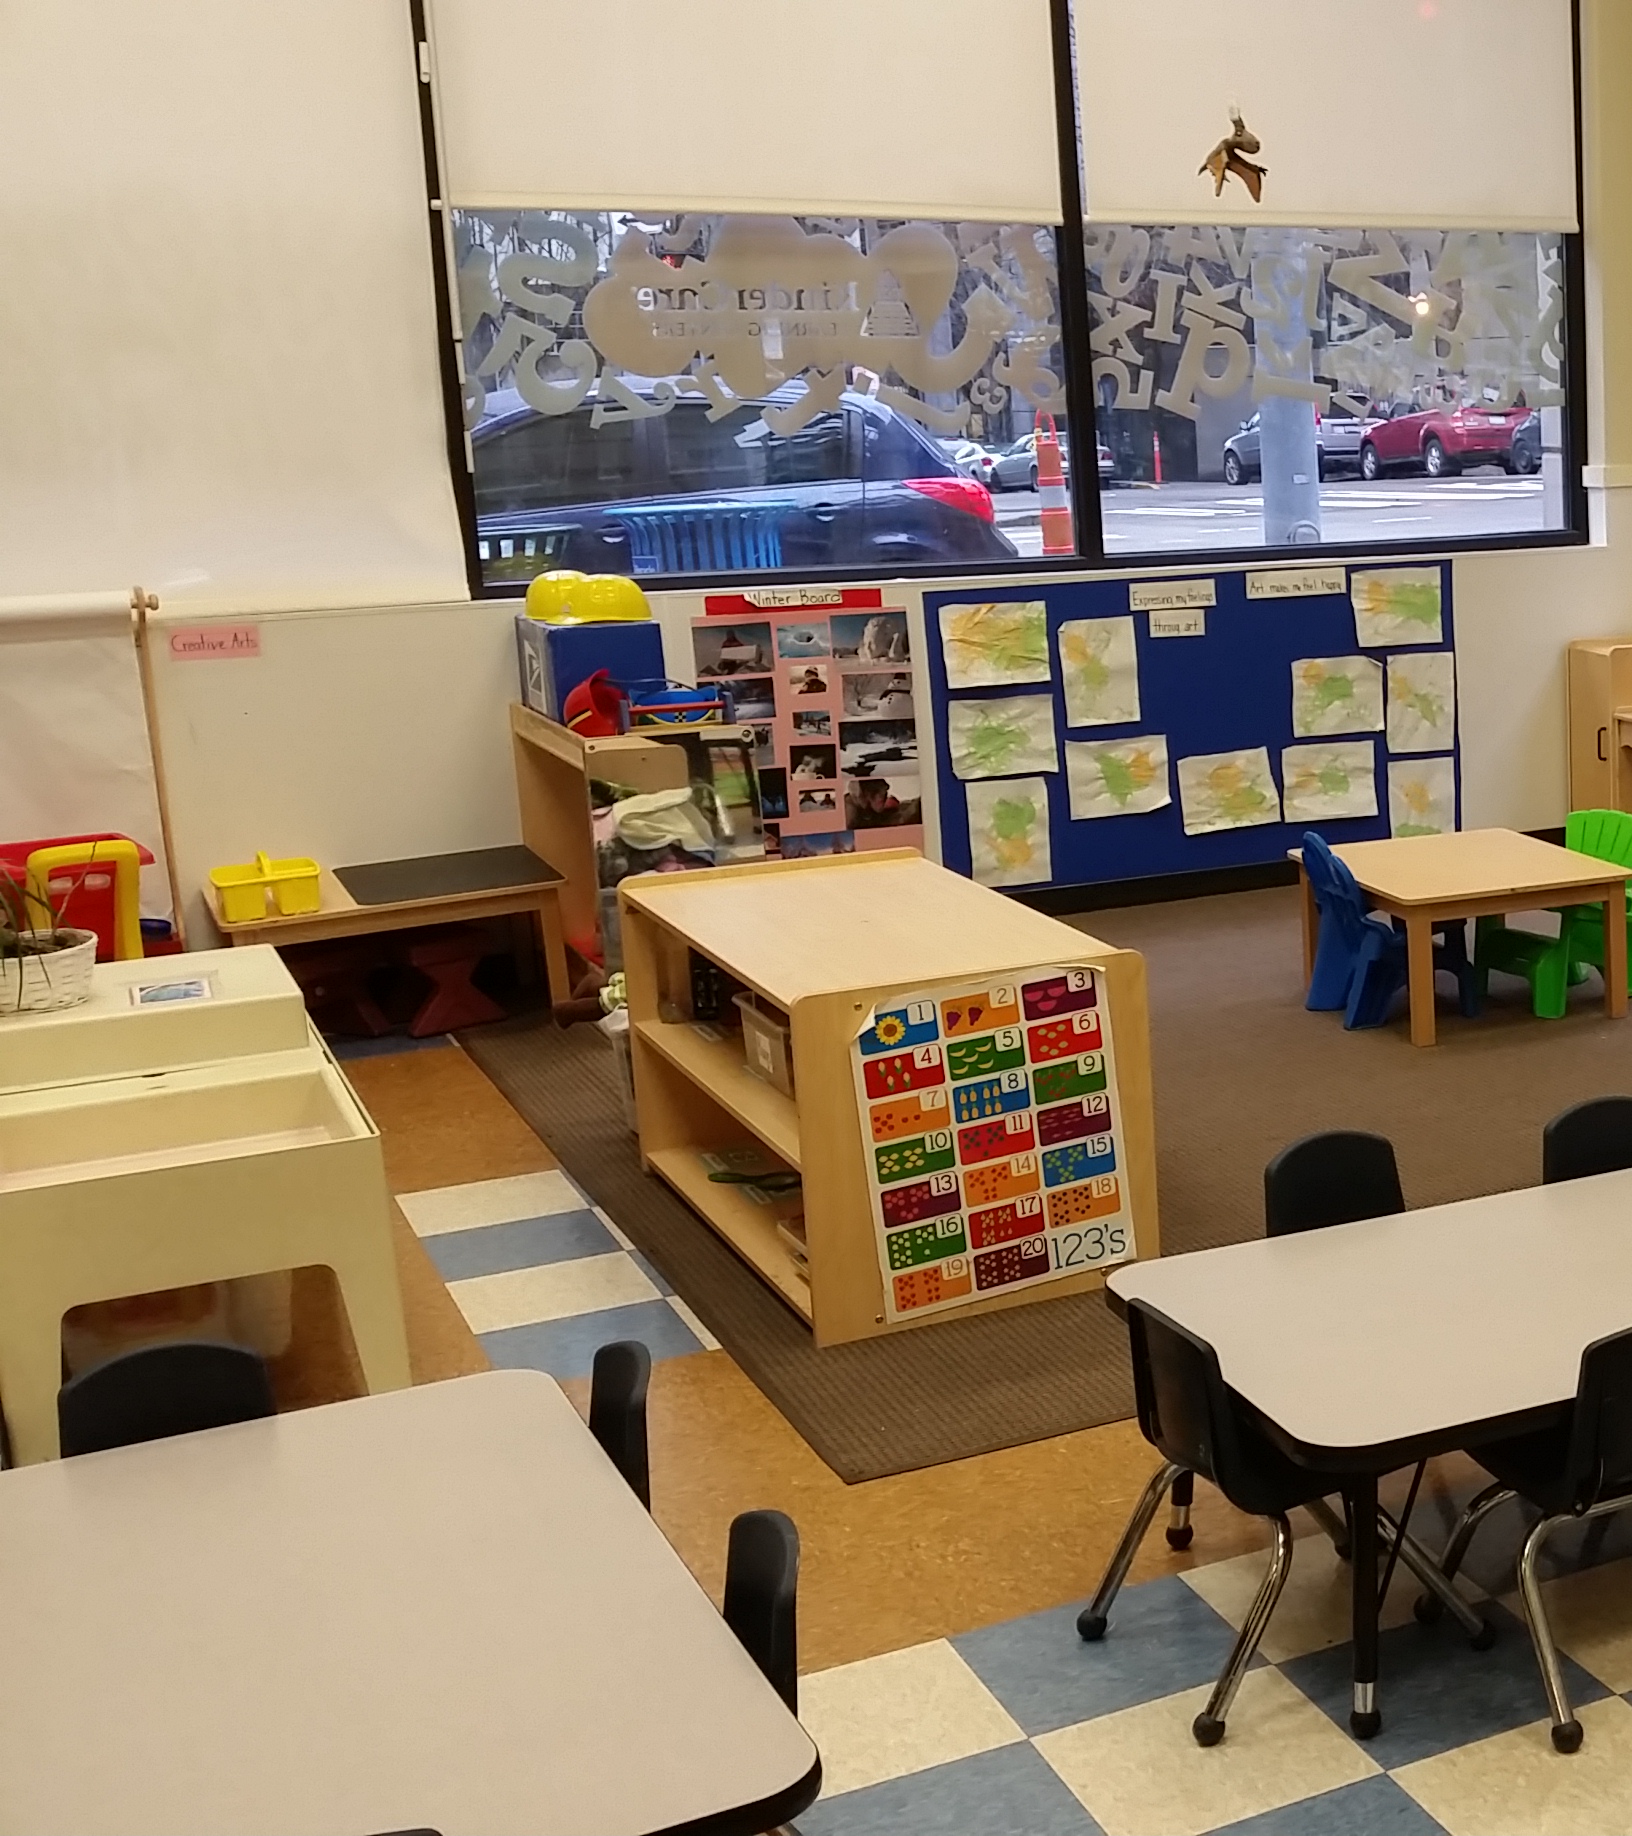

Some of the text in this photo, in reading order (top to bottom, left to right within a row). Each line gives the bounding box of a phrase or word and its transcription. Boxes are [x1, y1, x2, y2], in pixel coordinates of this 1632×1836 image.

[1249, 581, 1263, 593] Art
[748, 589, 840, 606] Winter Board
[1184, 619, 1198, 632] art
[171, 631, 258, 652] Creative Arts
[1074, 973, 1085, 987] 3
[997, 989, 1008, 1003] 2
[917, 1005, 927, 1021] 1
[1079, 1014, 1090, 1029] 6
[1002, 1032, 1013, 1046] 5
[920, 1049, 932, 1063] 4
[1083, 1057, 1095, 1071] 9
[1007, 1073, 1019, 1089] 8
[929, 1092, 938, 1106] 7
[1086, 1096, 1104, 1112] 12
[1013, 1115, 1024, 1131] 11
[929, 1133, 947, 1148] 10
[1090, 1139, 1107, 1154] 15
[1015, 1157, 1032, 1173] 14
[934, 1176, 952, 1191] 13
[1095, 1179, 1112, 1195] 18
[1020, 1199, 1037, 1214] 17
[940, 1218, 958, 1234] 16
[1022, 1238, 1043, 1257] 20
[1051, 1224, 1126, 1270] 123's
[946, 1261, 962, 1277] 19
